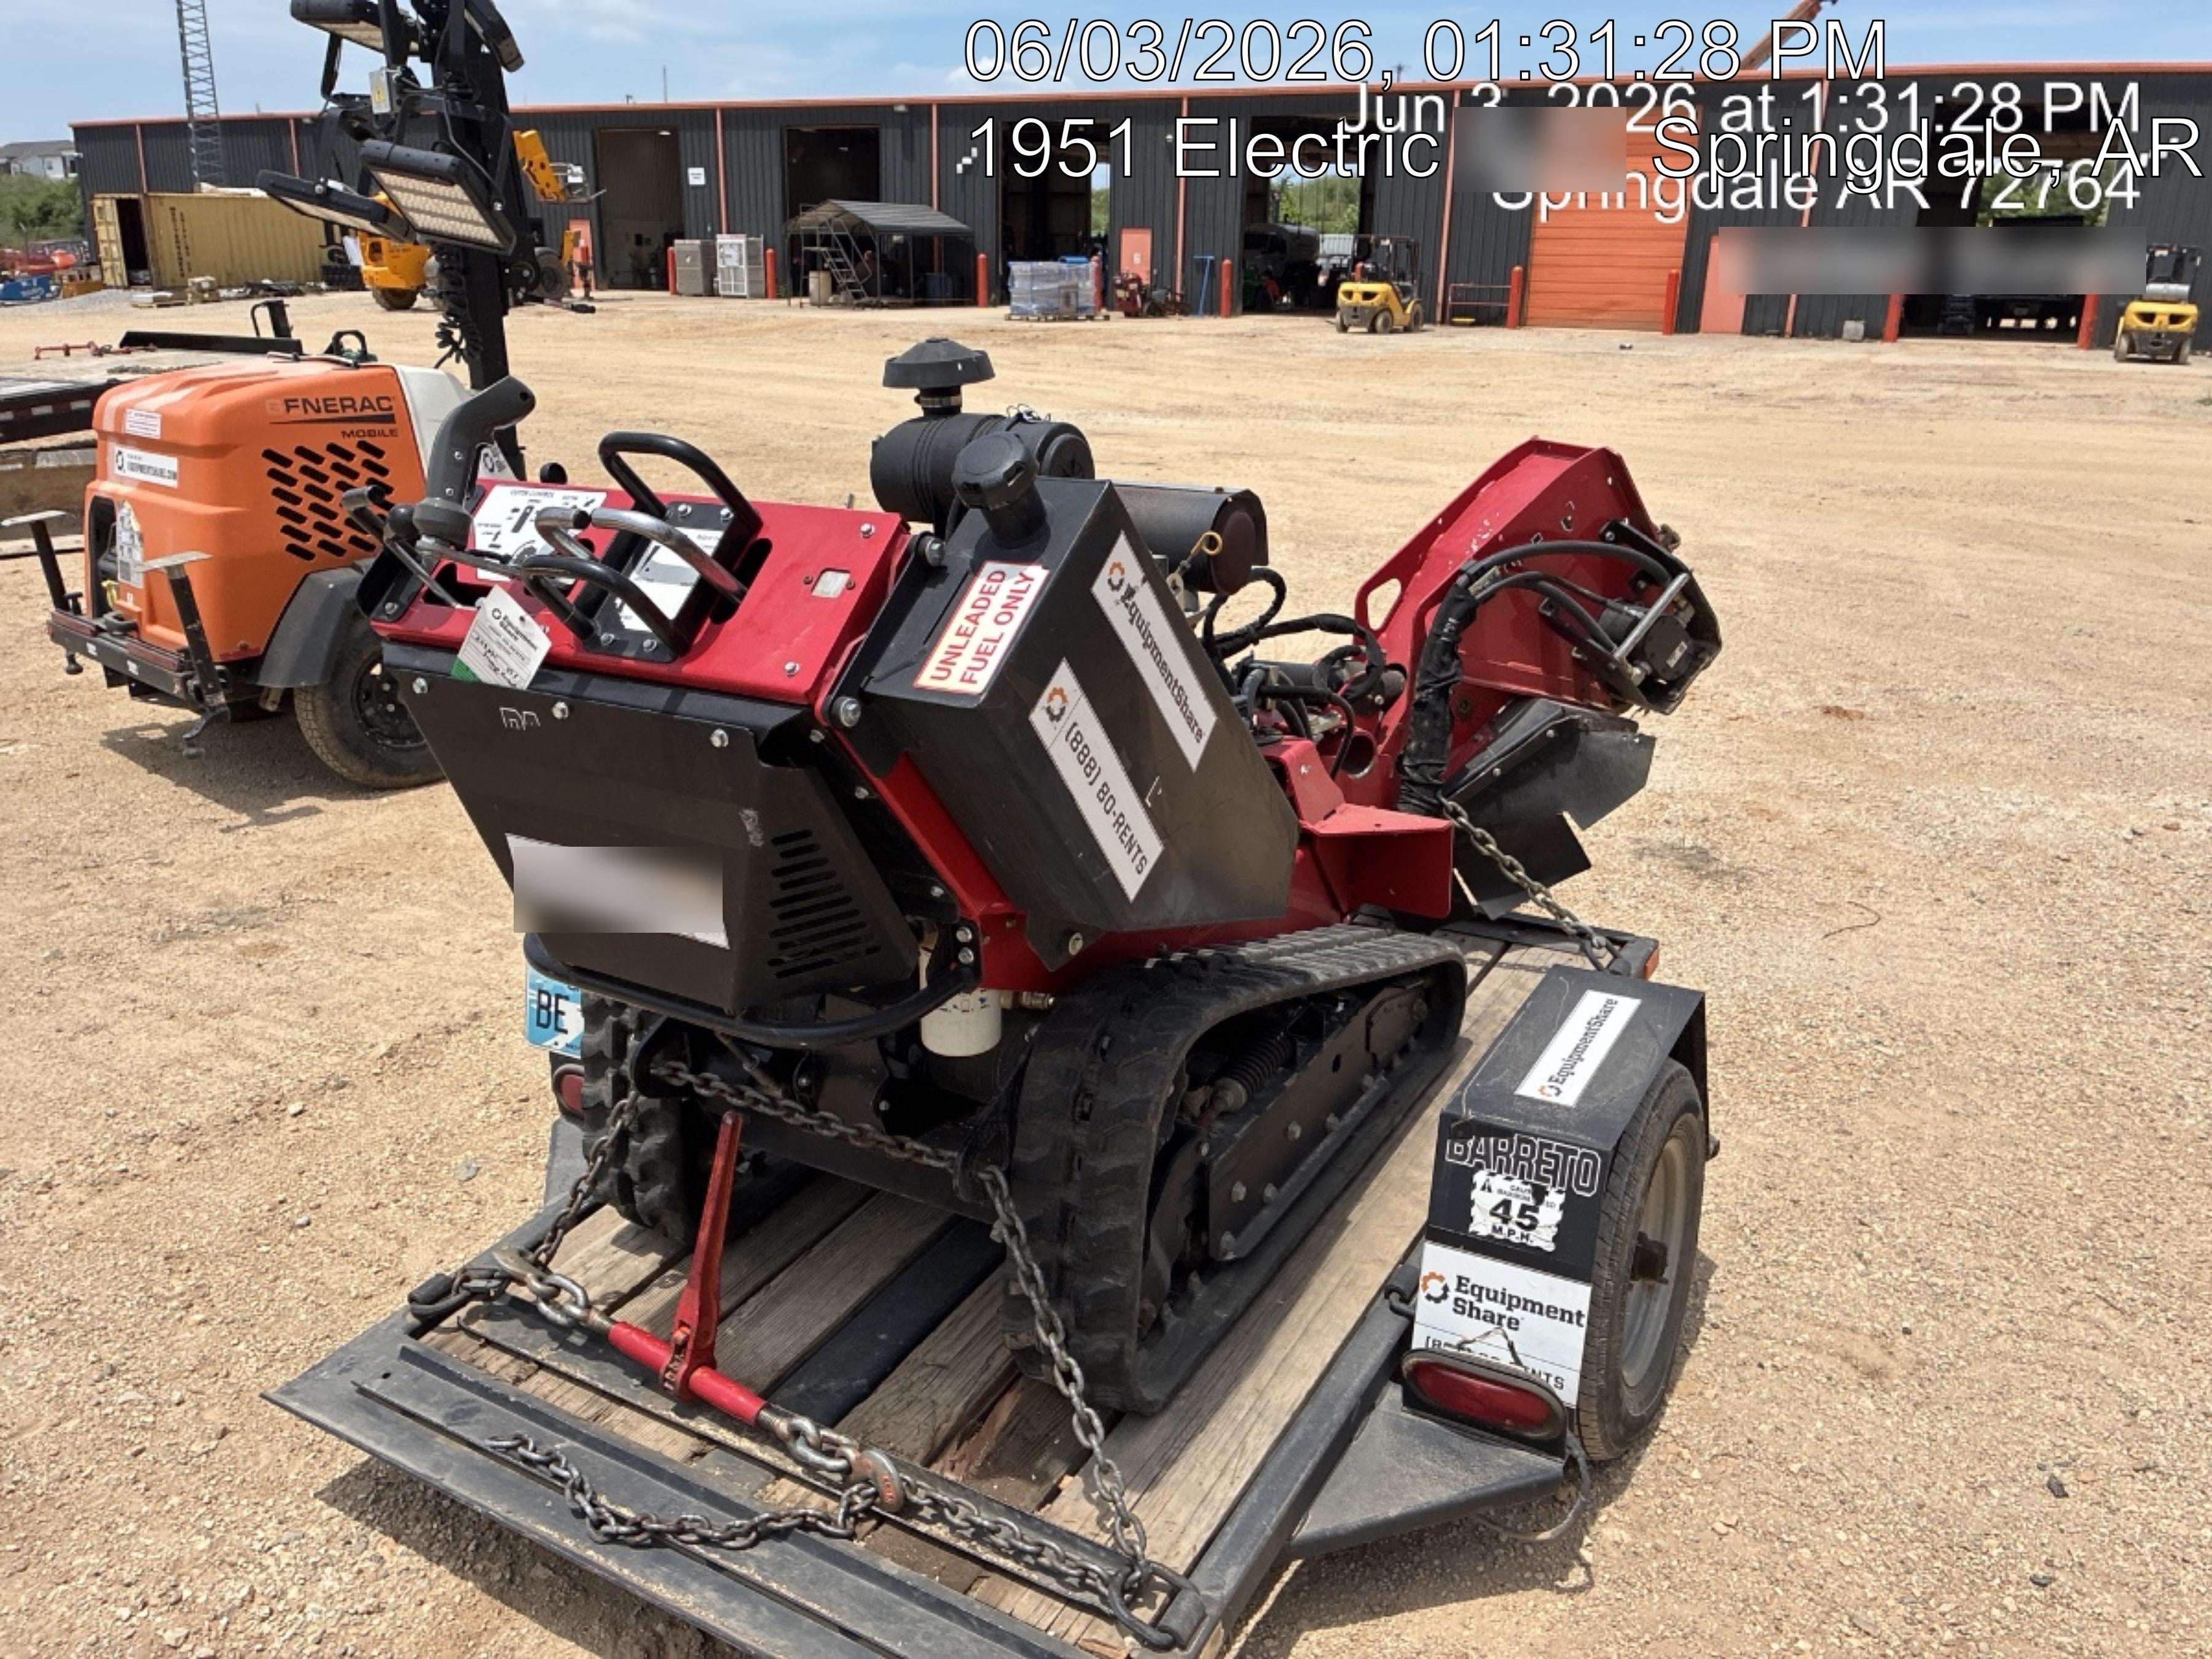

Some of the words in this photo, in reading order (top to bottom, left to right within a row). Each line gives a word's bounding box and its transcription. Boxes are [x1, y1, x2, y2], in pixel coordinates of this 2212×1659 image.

[929, 570, 1007, 681] UNLEADED
[959, 632, 1005, 684] FUEL
[993, 571, 1035, 626] ONLY
[1120, 582, 1204, 743] EquipmentShare
[1064, 721, 1102, 786] (888)
[1096, 781, 1148, 876] 80-RENTS
[1547, 998, 1618, 1084] EquipmentShare
[1445, 1132, 1601, 1197] BARRETO
[1489, 1198, 1540, 1232] 45
[1452, 1296, 1521, 1332] Share
[1454, 1274, 1586, 1328] Equipment
